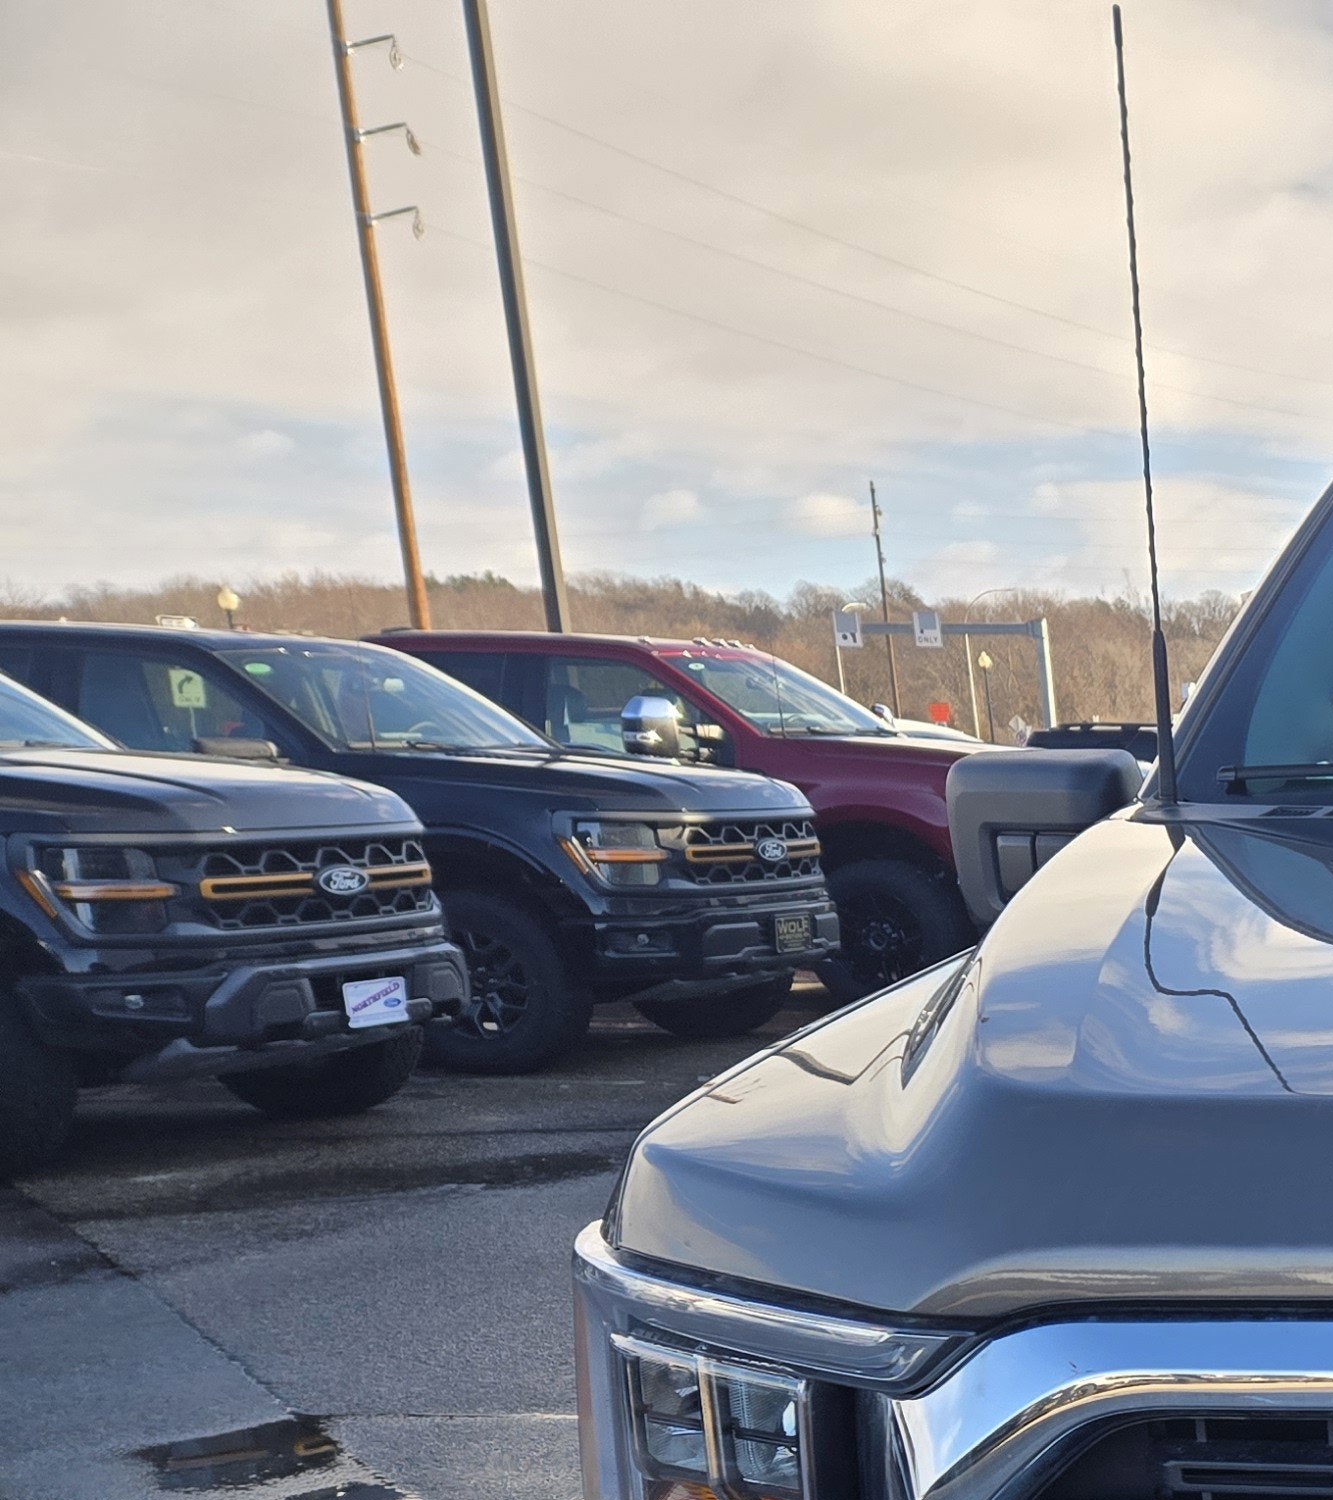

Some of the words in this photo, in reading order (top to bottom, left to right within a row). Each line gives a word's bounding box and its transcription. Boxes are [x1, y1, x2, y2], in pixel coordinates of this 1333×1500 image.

[918, 635, 939, 643] ONLY
[330, 871, 360, 890] Ford
[778, 917, 809, 934] WOLF
